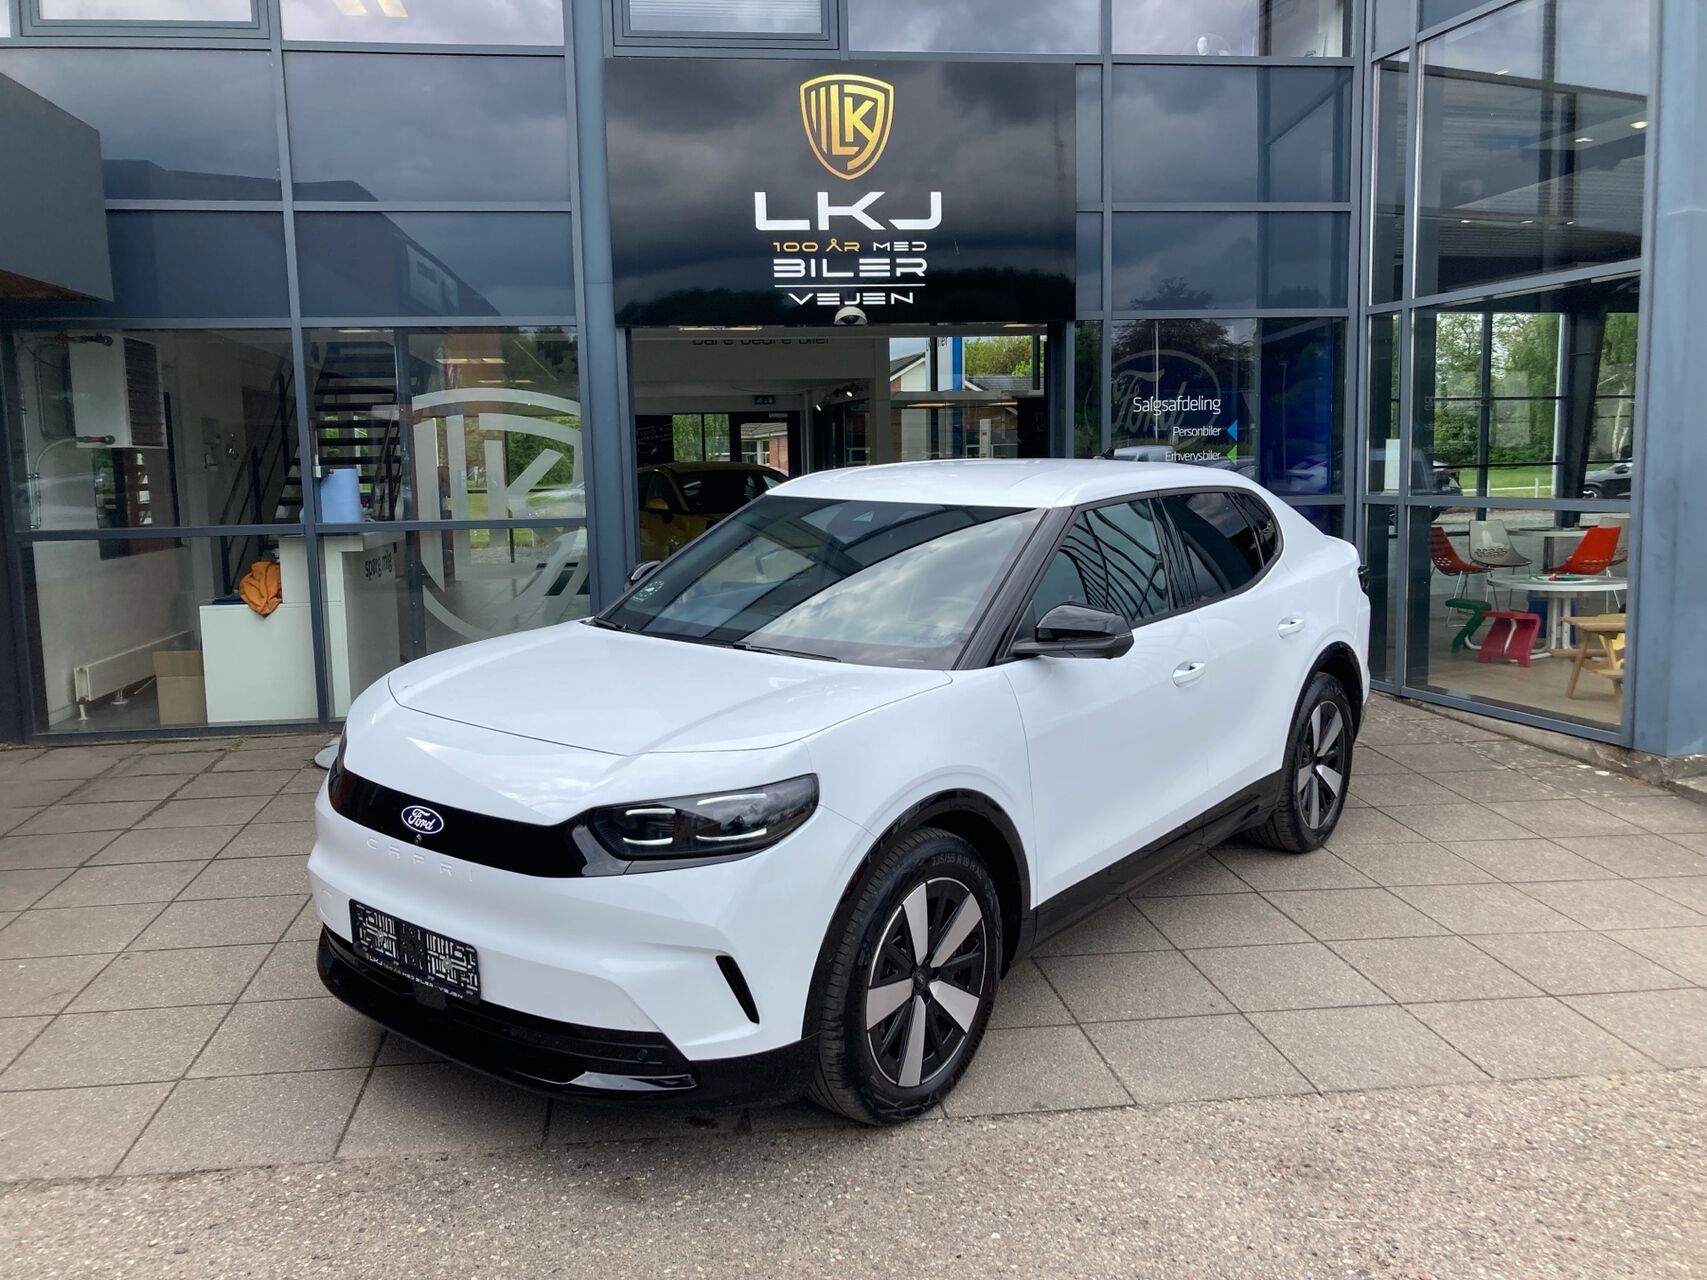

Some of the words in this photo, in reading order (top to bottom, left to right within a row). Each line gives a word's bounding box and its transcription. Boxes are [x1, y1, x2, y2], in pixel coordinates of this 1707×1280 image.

[754, 191, 943, 230] LKJ
[772, 241, 819, 252] 100
[825, 238, 861, 252] ÅR
[872, 241, 928, 252] MED
[773, 257, 928, 277] BILER
[787, 292, 914, 305] VEJEN
[1132, 394, 1222, 416] Salgsafdeling
[1172, 425, 1222, 437] Personbiler
[1165, 449, 1221, 461] Erhvervsbiler
[407, 807, 436, 831] Ford
